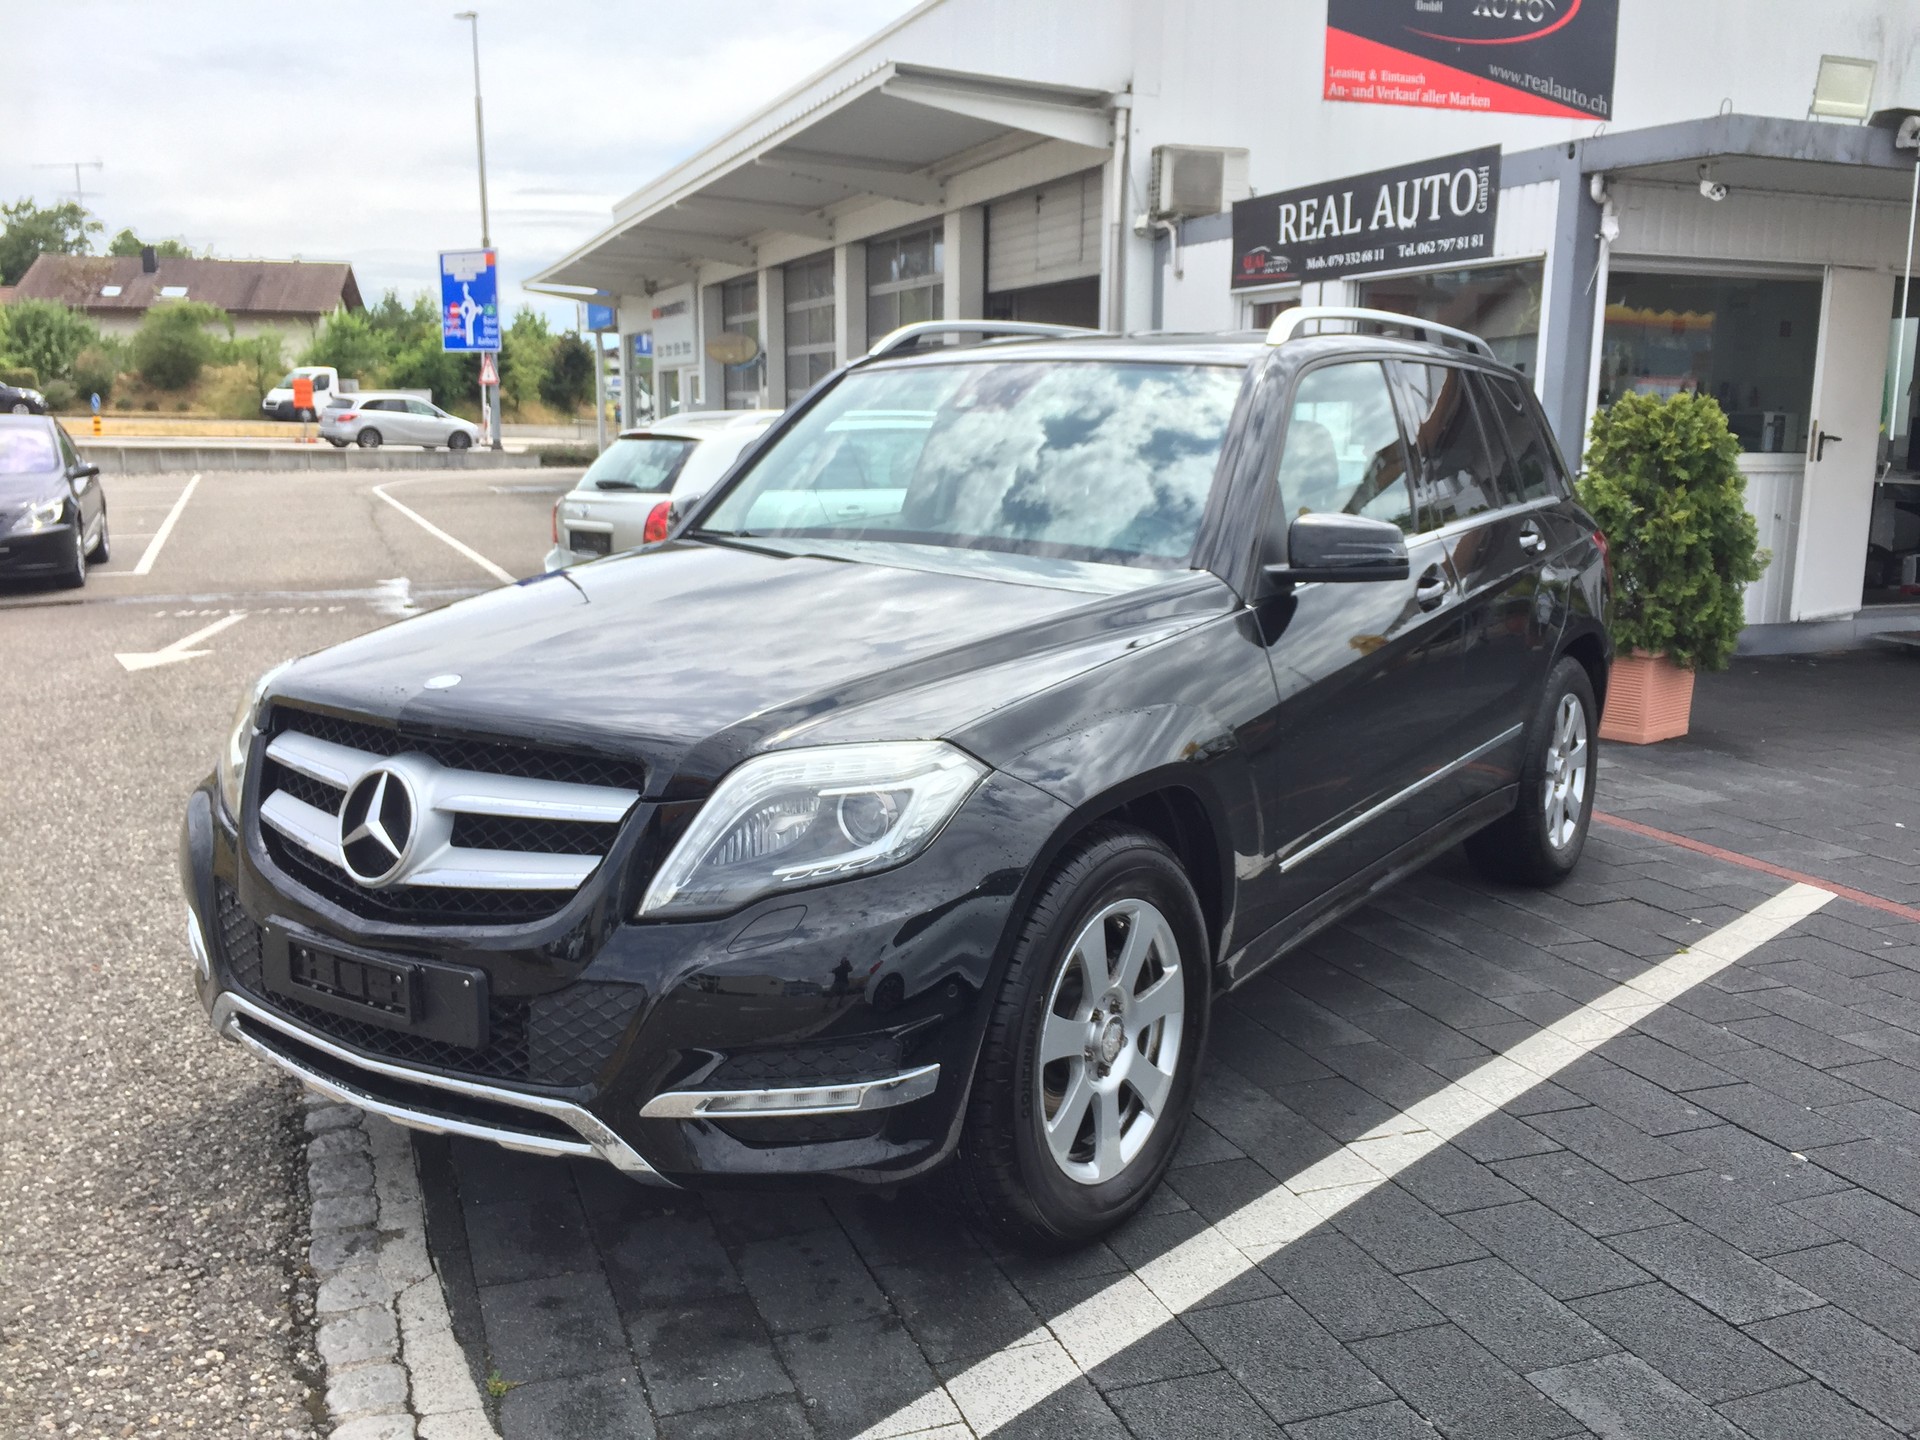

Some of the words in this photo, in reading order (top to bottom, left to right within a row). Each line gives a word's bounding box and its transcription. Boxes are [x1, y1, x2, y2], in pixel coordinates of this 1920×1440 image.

[1472, 0, 1544, 23] AUTO
[1329, 66, 1365, 82] Leasing
[1368, 69, 1377, 81] &
[1381, 69, 1425, 85] Eintausch
[1489, 63, 1608, 114] www.realauto.ch
[1328, 82, 1349, 97] An-
[1352, 83, 1374, 98] und
[1376, 85, 1420, 102] Verkauf
[1421, 89, 1447, 104] aller
[1449, 91, 1491, 108] Marken
[1476, 165, 1490, 214] GmbH
[1278, 192, 1362, 245] REAL
[1368, 168, 1478, 230] AUTO
[1399, 244, 1416, 258] Tel.
[1417, 241, 1436, 254] 062
[1437, 238, 1456, 252] 797
[1457, 236, 1469, 249] 81
[1470, 234, 1484, 247] 81
